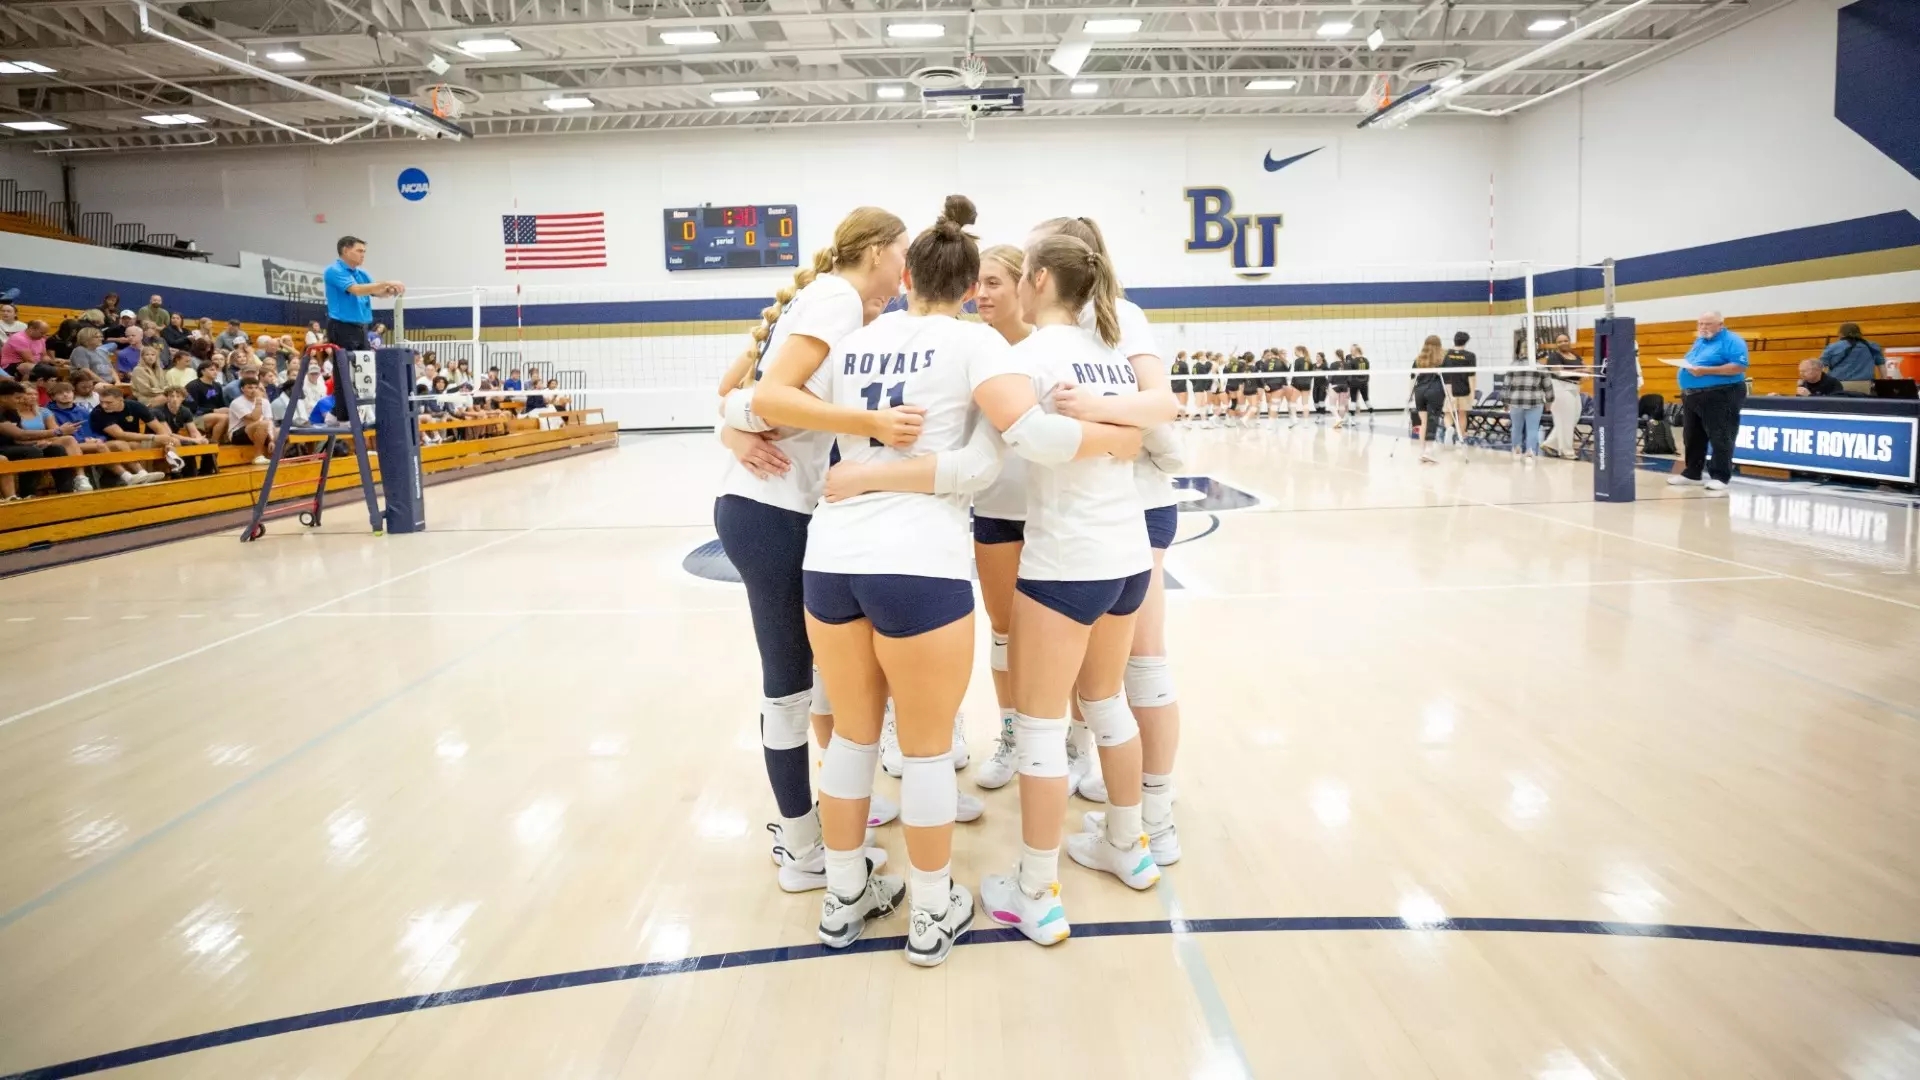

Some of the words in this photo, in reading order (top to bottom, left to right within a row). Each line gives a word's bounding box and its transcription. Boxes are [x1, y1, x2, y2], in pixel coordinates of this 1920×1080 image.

[401, 183, 429, 194] NCAA
[683, 221, 696, 240] 0
[780, 217, 793, 237] 0
[1183, 185, 1283, 281] BU
[745, 230, 756, 246] 0
[271, 268, 325, 298] MIAC
[843, 349, 935, 375] ROYALS
[1072, 363, 1136, 384] ROYALS
[1757, 426, 1779, 451] OF
[1781, 428, 1814, 455] THE
[1816, 431, 1893, 462] ROYALS
